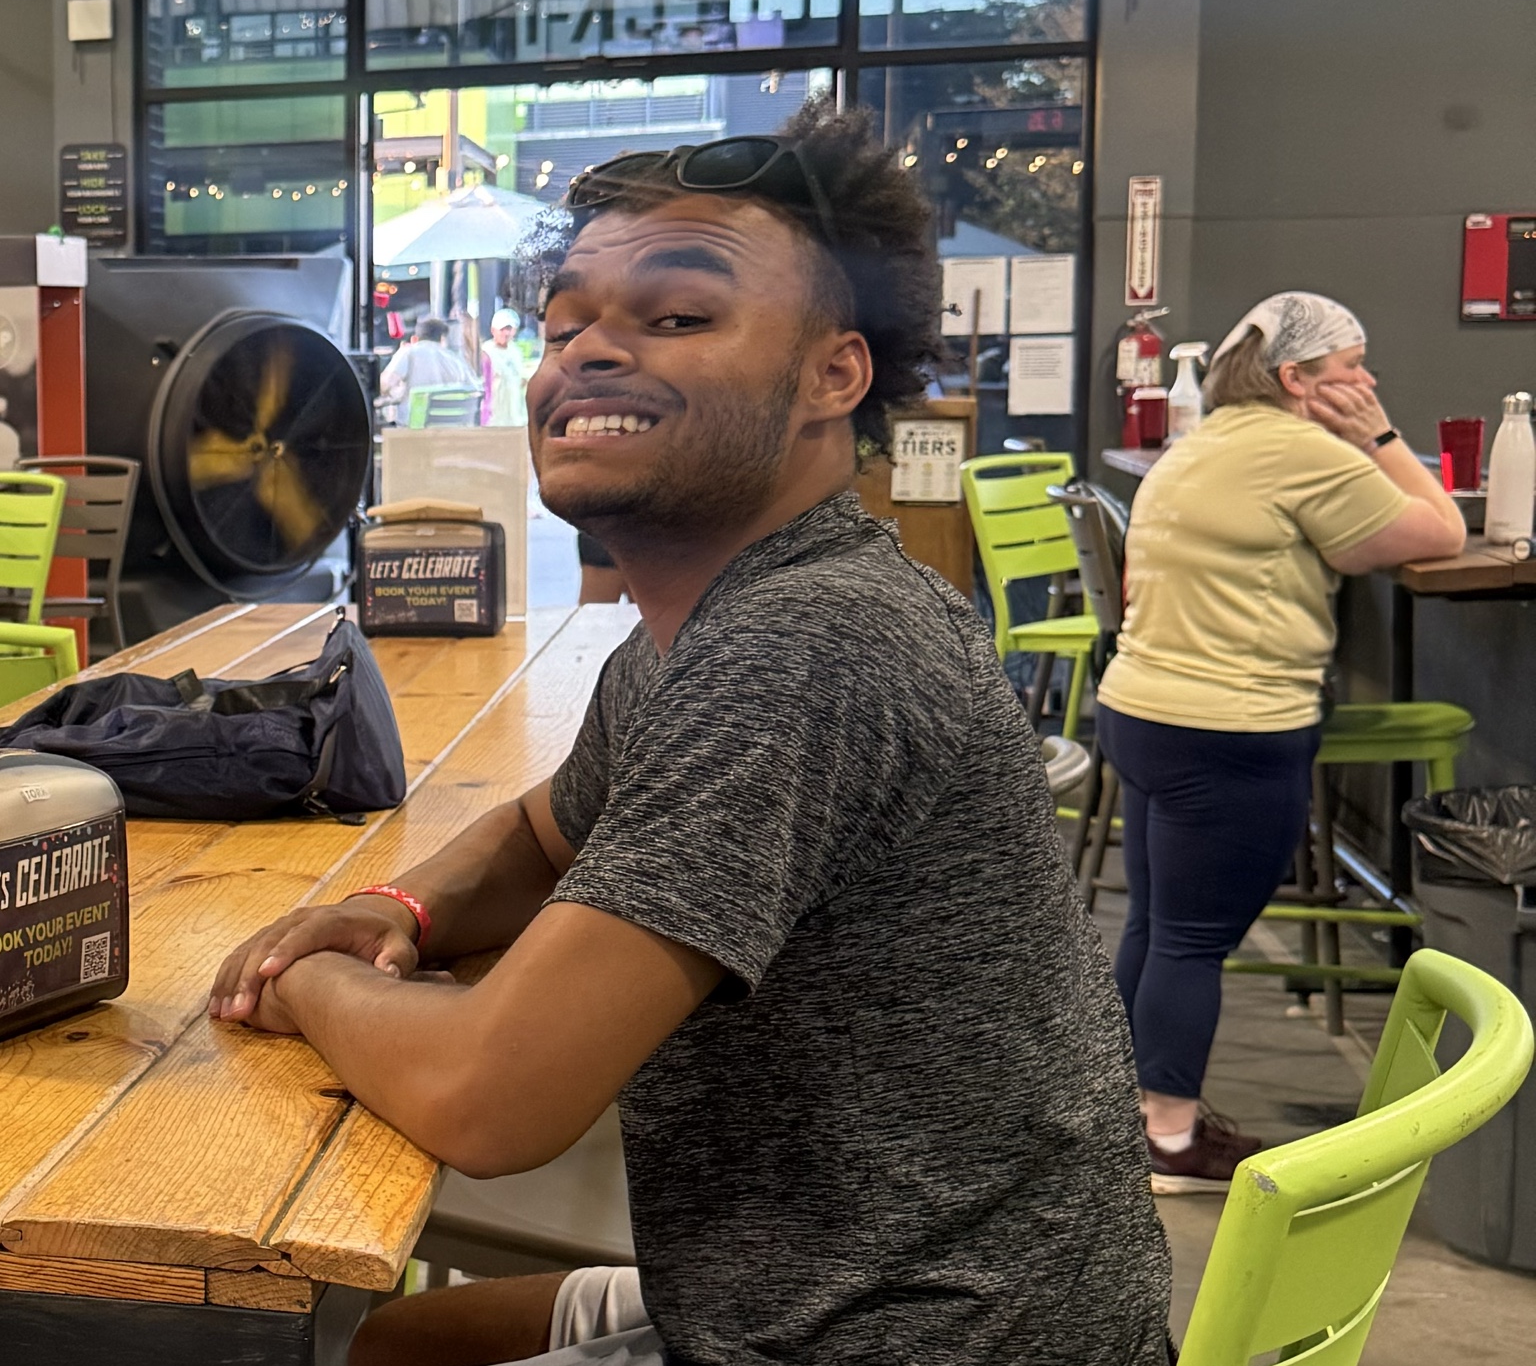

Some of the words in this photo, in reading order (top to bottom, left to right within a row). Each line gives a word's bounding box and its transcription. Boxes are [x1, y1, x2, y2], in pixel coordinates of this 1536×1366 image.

[900, 438, 957, 457] TIERS
[401, 555, 480, 579] CELEBRATE
[374, 586, 405, 597] BOOK
[407, 586, 438, 596] YOUR
[439, 585, 477, 595] EVENT
[15, 834, 111, 908] CELEBRATE
[25, 915, 64, 945] YOUR
[65, 900, 112, 930] EVENT
[23, 935, 74, 969] TODAY!
